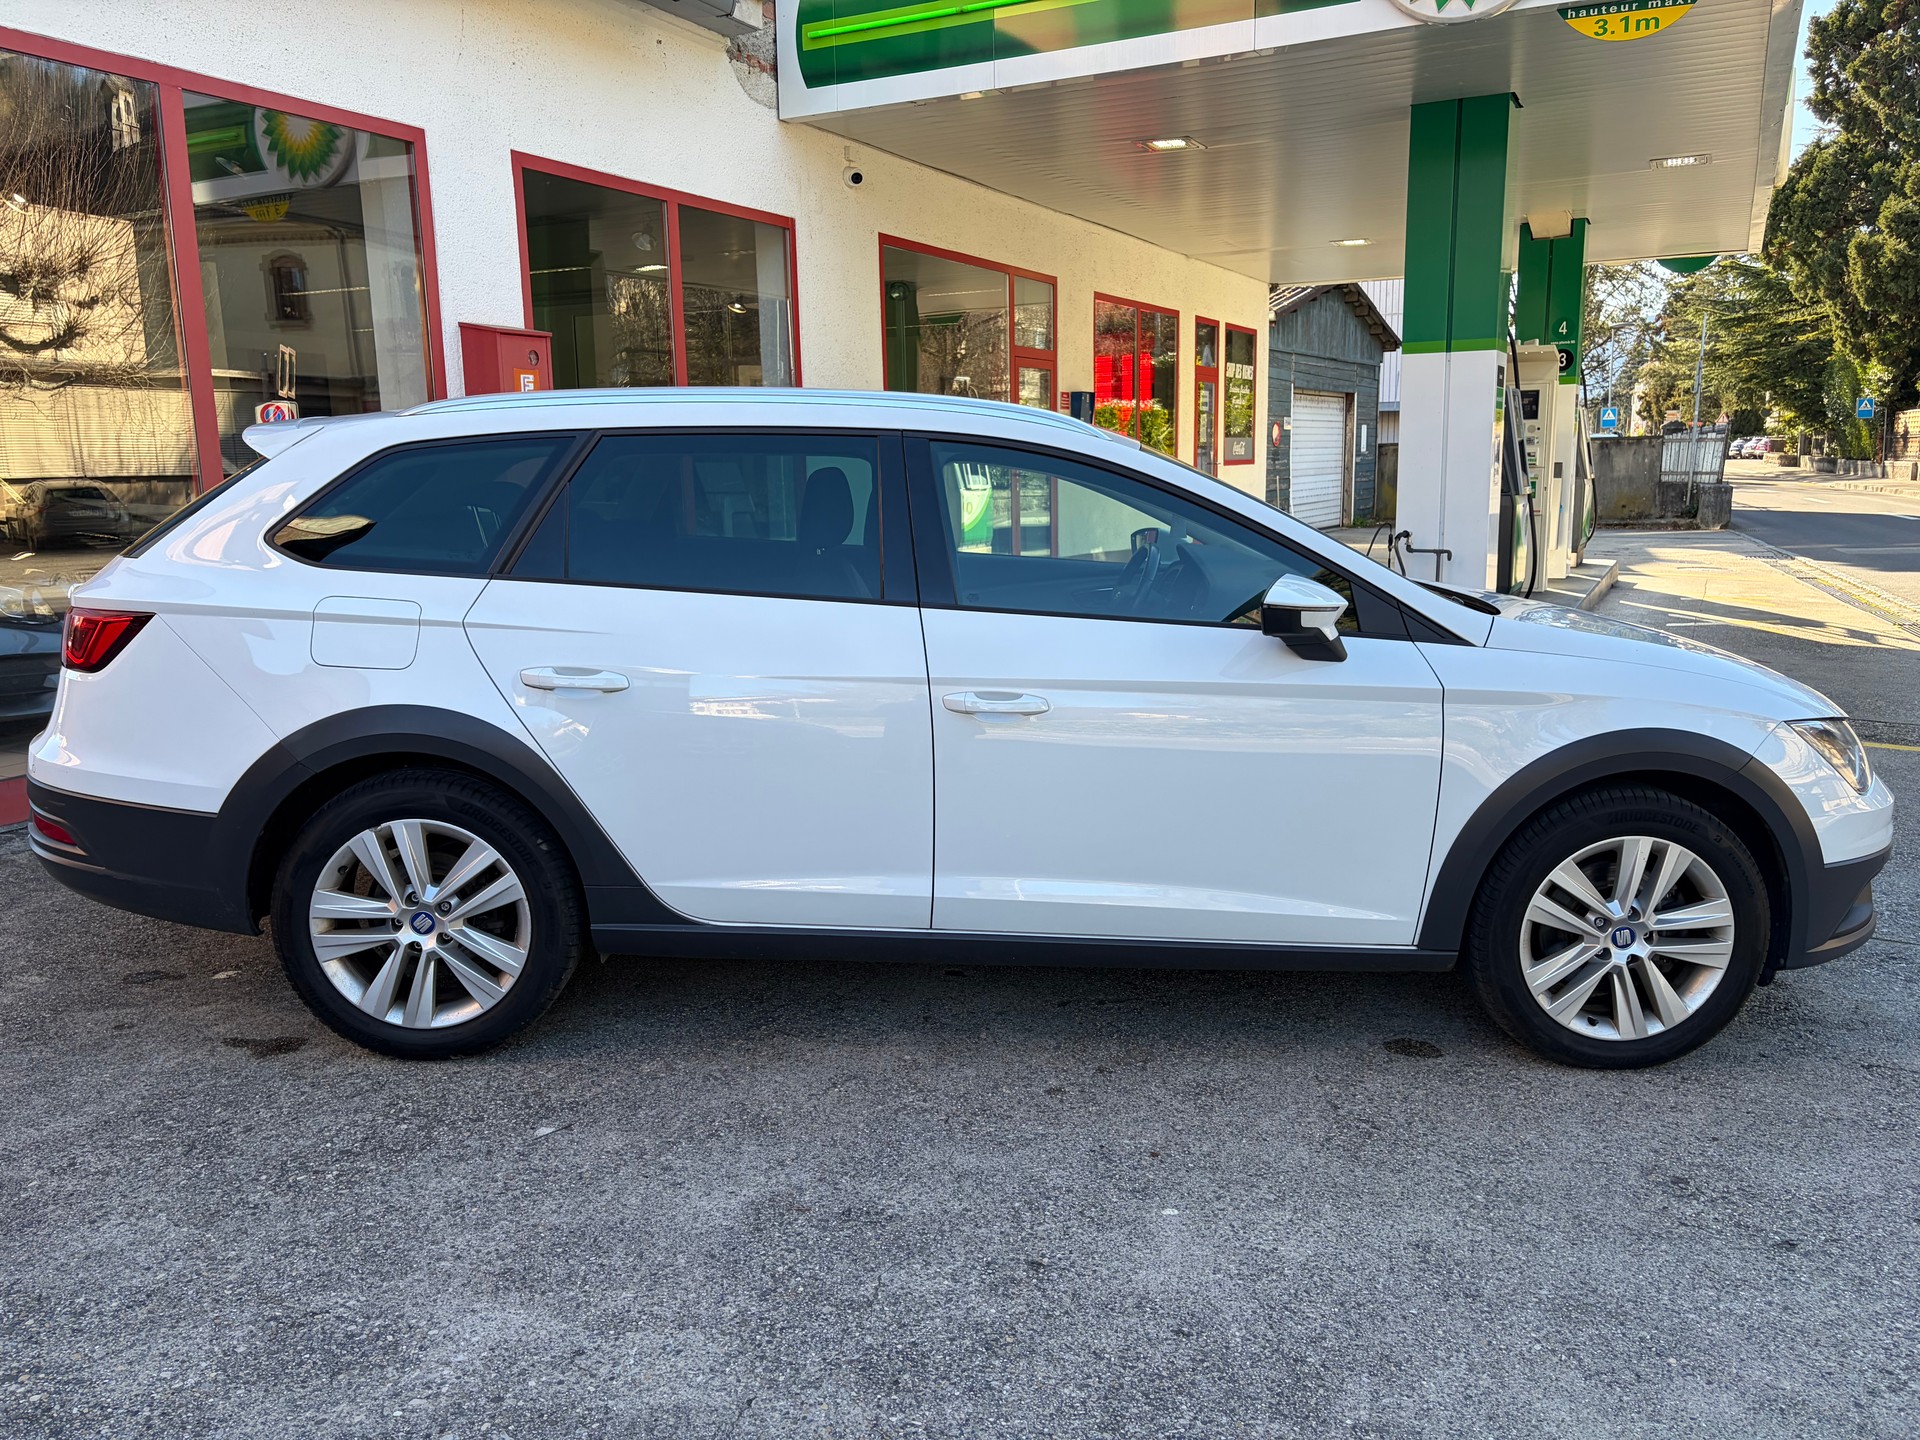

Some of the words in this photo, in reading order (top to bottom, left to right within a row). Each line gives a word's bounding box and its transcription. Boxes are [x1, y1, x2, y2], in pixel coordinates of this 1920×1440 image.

[1567, 2, 1639, 19] hauteur
[1593, 15, 1660, 37] 3.1m
[1558, 320, 1568, 336] 4
[1558, 352, 1567, 367] 3
